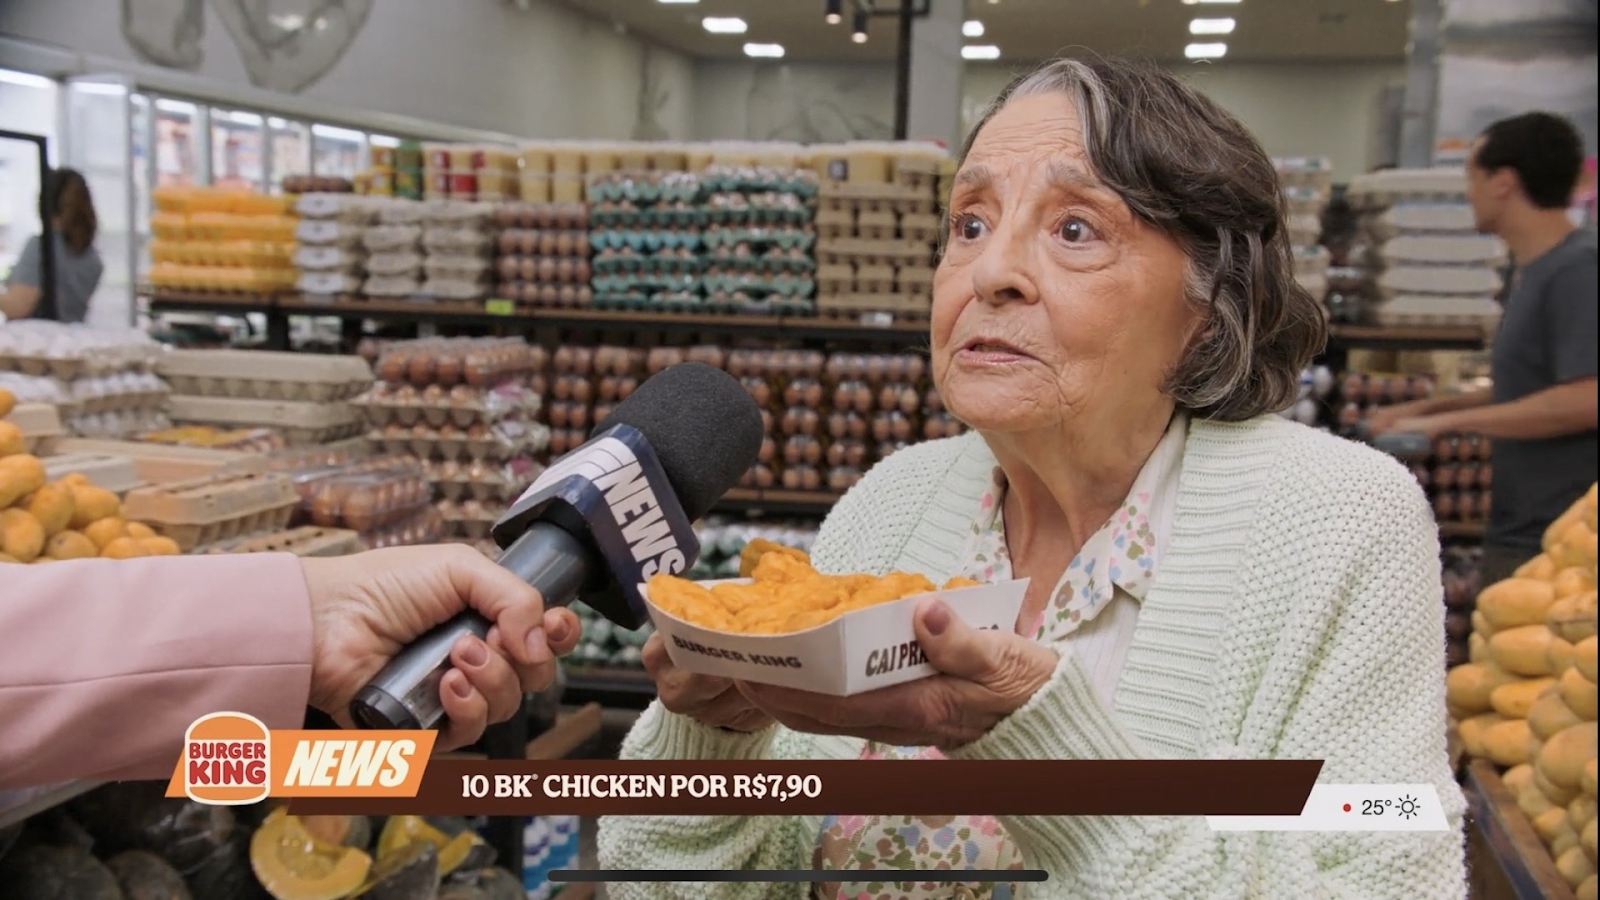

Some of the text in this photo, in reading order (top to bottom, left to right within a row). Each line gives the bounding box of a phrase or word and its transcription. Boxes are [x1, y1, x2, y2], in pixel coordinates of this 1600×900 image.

[592, 460, 686, 583] NEWS
[671, 634, 802, 668] BURGER KING
